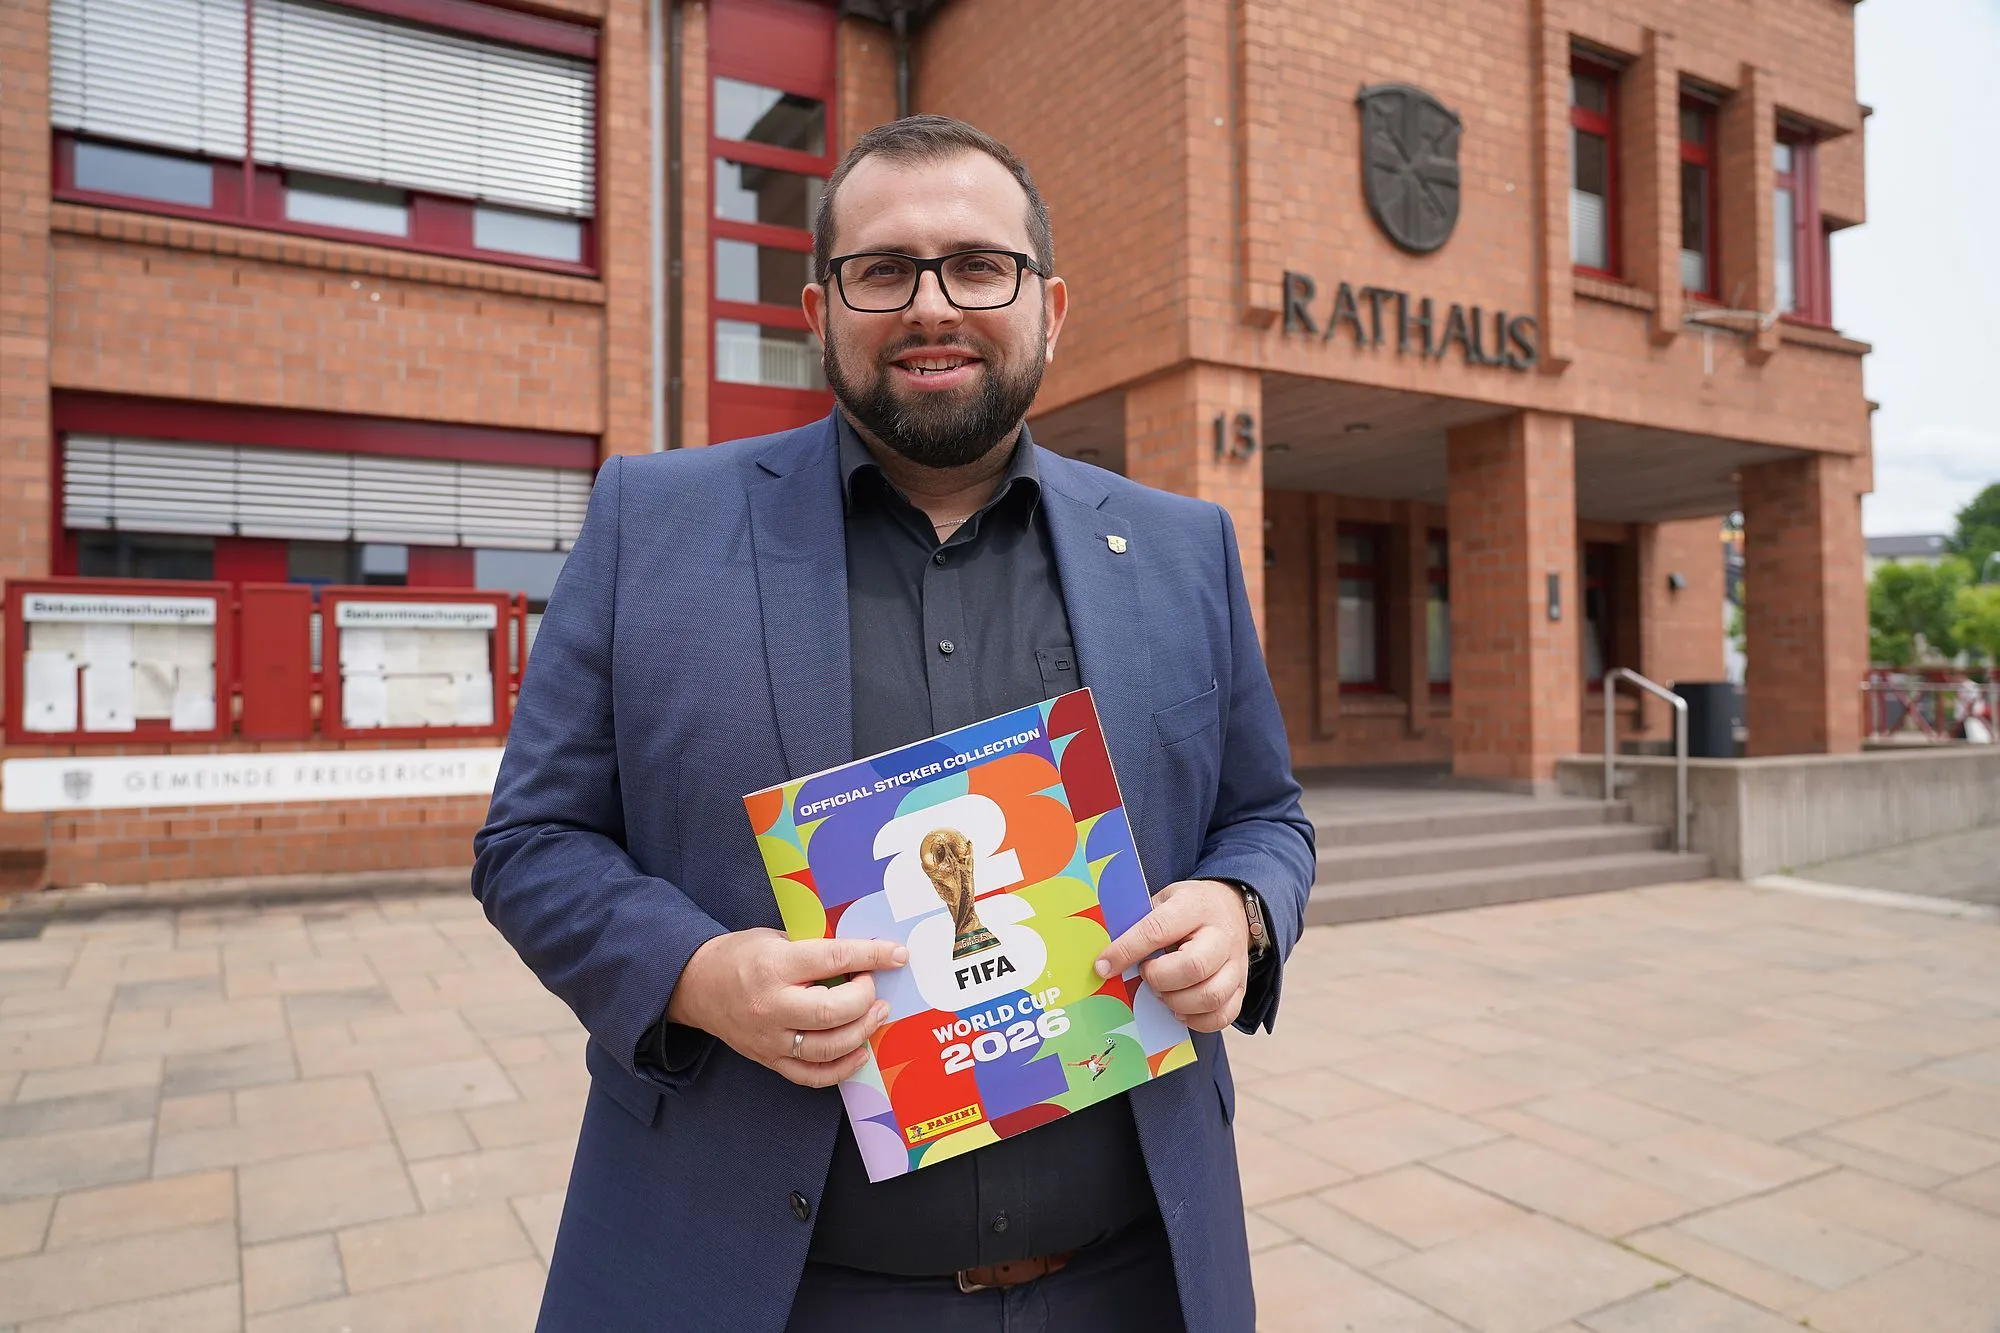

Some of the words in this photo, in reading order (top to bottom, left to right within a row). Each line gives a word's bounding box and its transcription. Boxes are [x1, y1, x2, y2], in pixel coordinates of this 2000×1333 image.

[1283, 270, 1538, 373] RATHAUS
[1213, 411, 1256, 462] 13
[33, 601, 209, 618] Bekanntmachungen
[344, 608, 492, 623] Bekanntmachungen
[123, 766, 276, 792] GEMEINDE
[294, 763, 467, 785] FREIGERICHT
[800, 786, 872, 817] OFFICIAL
[874, 762, 942, 793] STICKER
[943, 728, 1041, 770] COLLECTION
[954, 955, 1016, 990] FIFA
[932, 1004, 1015, 1044] WORLD
[1017, 987, 1061, 1014] CUP
[940, 1008, 1071, 1076] 2026
[926, 1107, 977, 1130] PANINI
